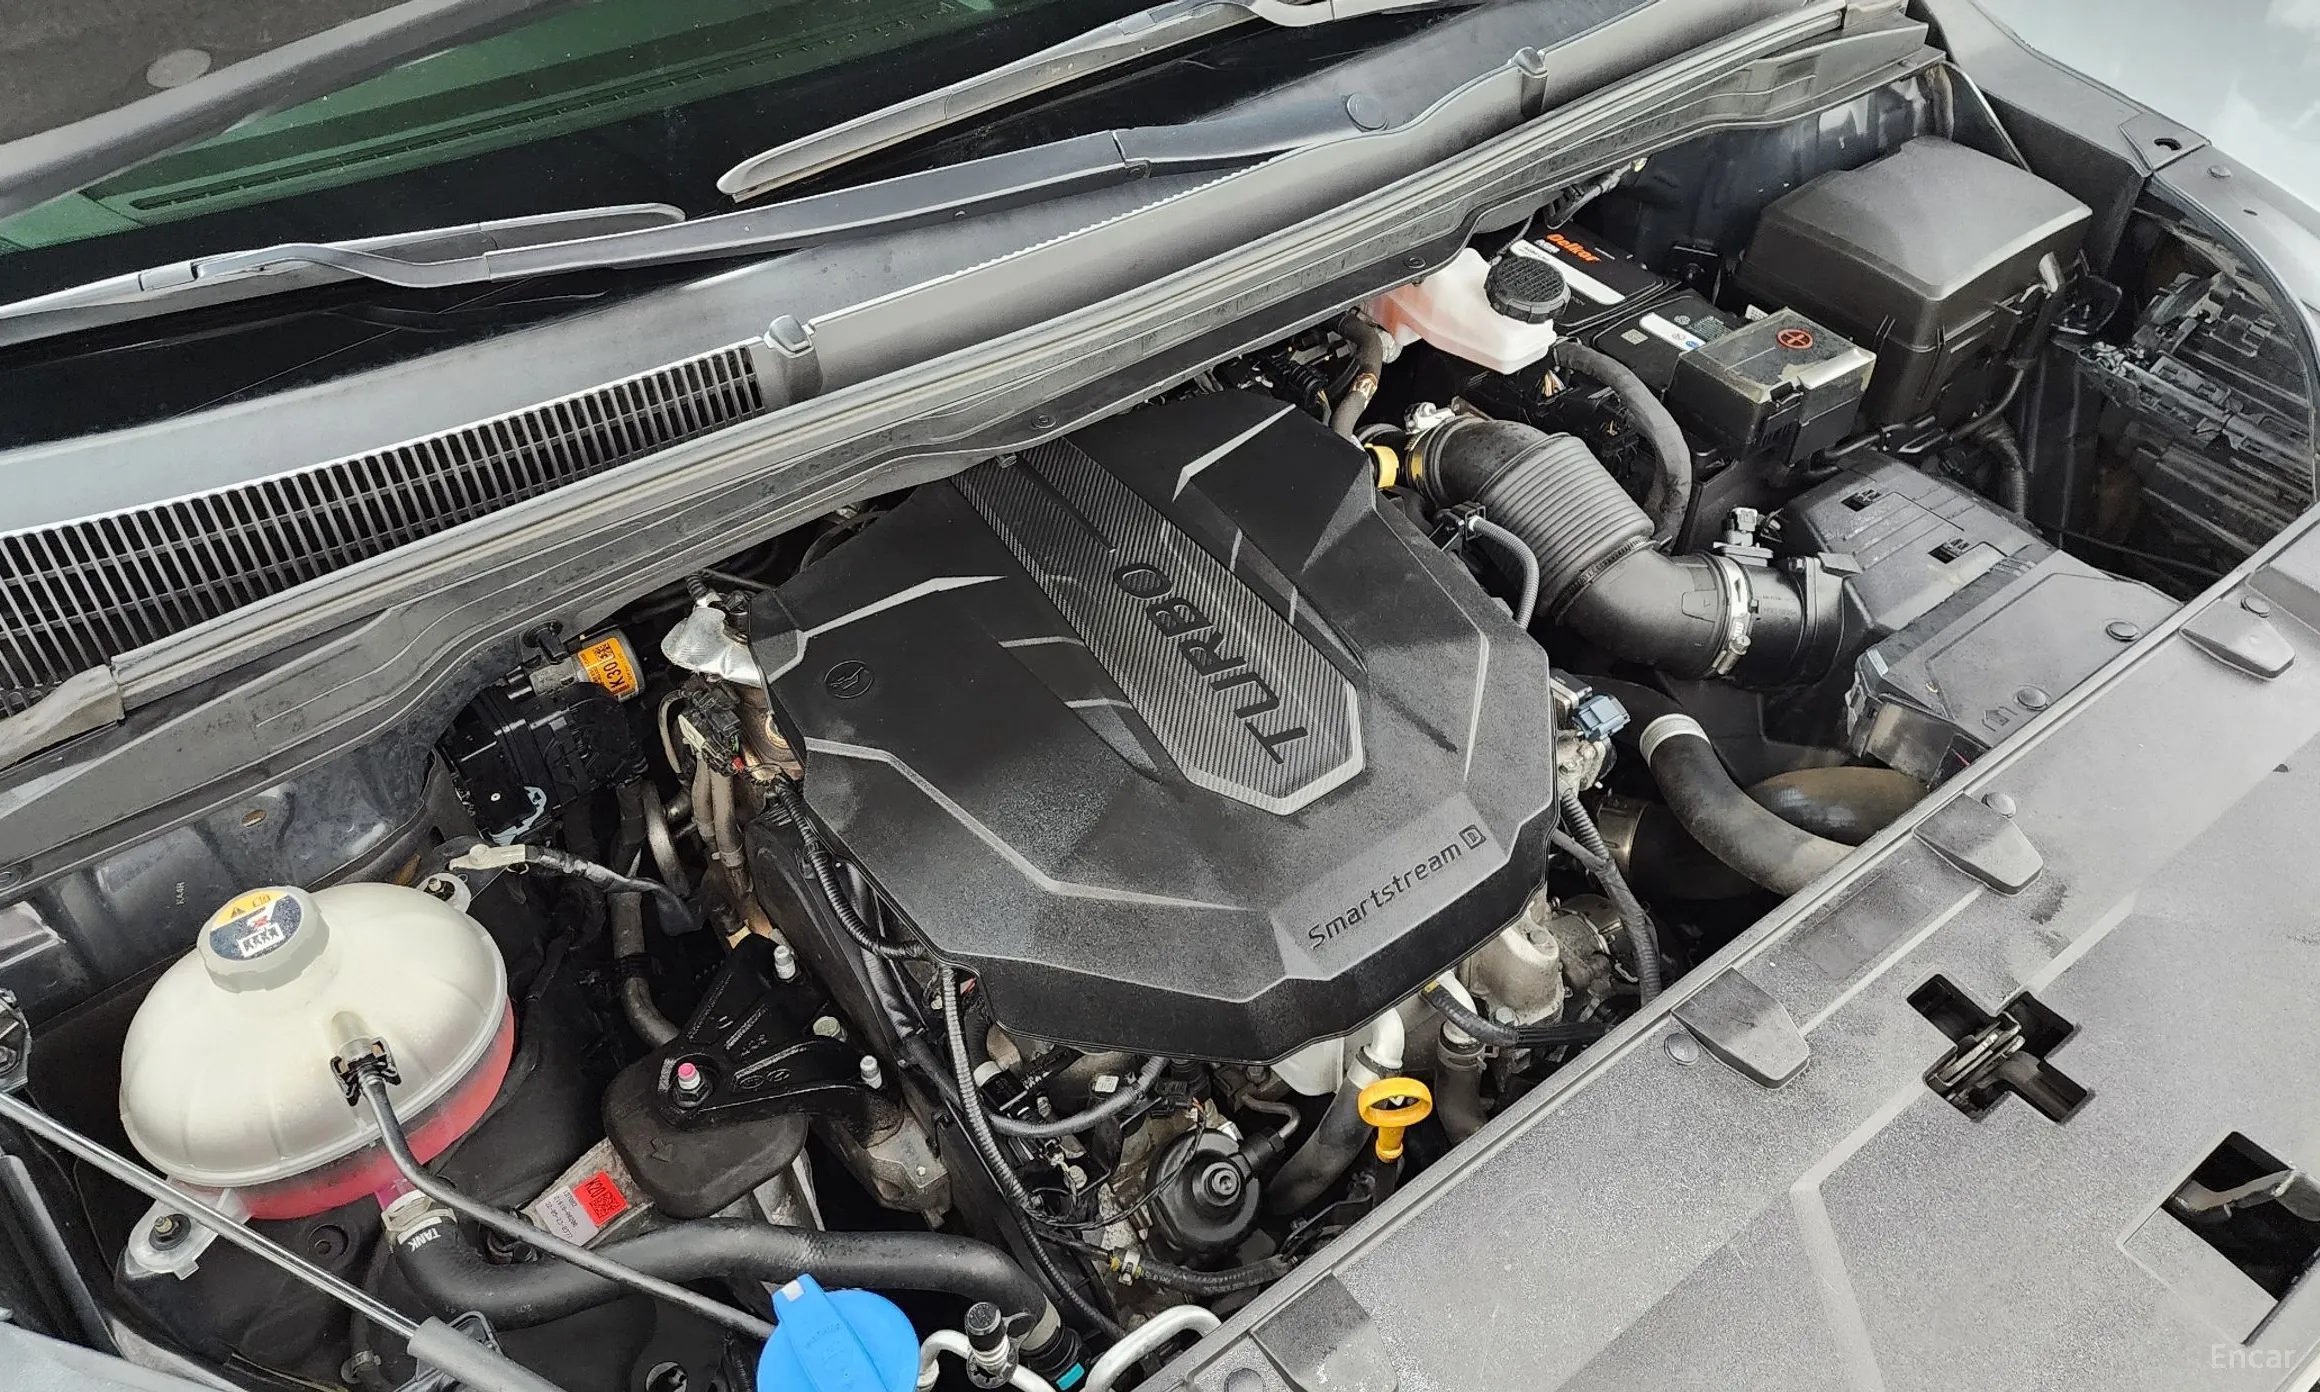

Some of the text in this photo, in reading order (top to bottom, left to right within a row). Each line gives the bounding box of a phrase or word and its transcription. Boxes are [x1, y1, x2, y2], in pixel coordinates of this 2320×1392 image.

[603, 662, 625, 688] K30
[1113, 563, 1308, 764] TURBO
[1308, 843, 1462, 949] Smartstream
[585, 1178, 606, 1203] K20
[408, 1227, 441, 1252] TANK
